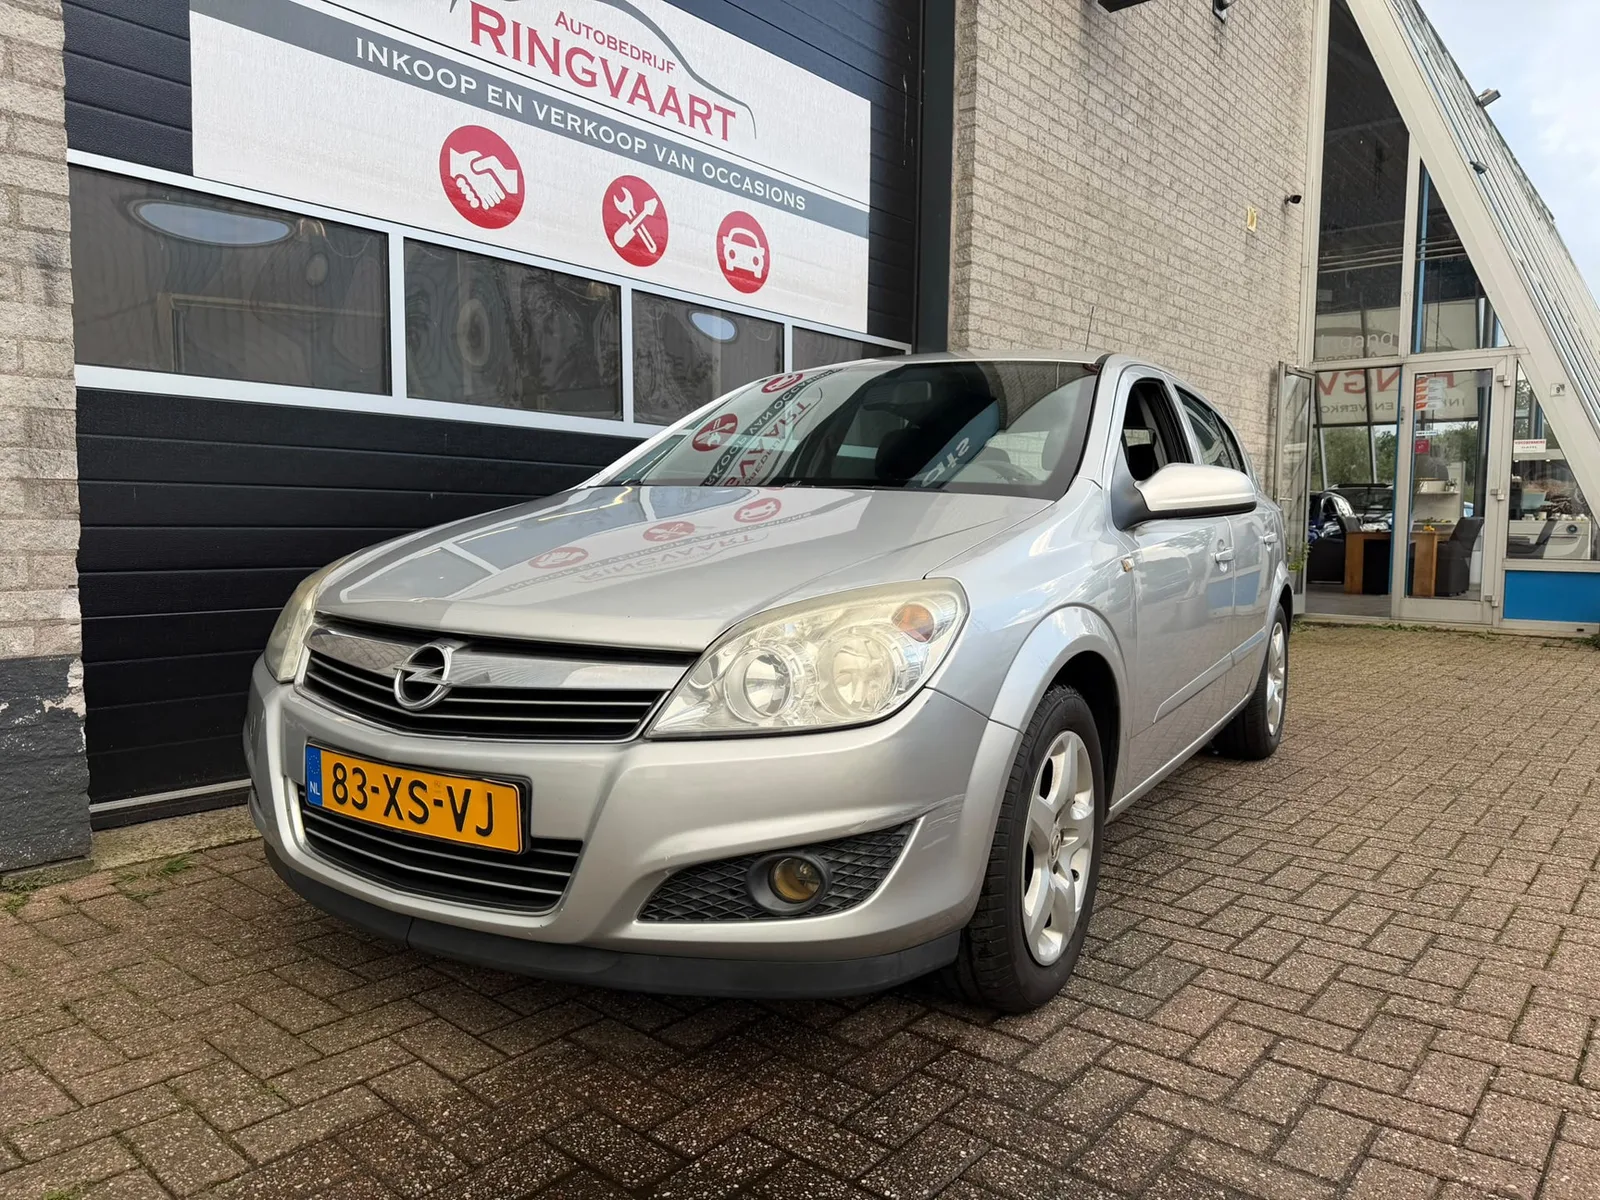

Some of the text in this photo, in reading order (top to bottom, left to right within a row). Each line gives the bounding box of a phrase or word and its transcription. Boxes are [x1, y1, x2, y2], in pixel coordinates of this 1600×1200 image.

[470, 1, 737, 142] RINGVAART
[555, 11, 676, 74] AUTOBEDRIJF
[356, 37, 806, 211] INKOOP EN VERKOOP VAN OCCASIONS
[309, 780, 321, 796] NL
[332, 762, 494, 837] 83-XS-VJ
